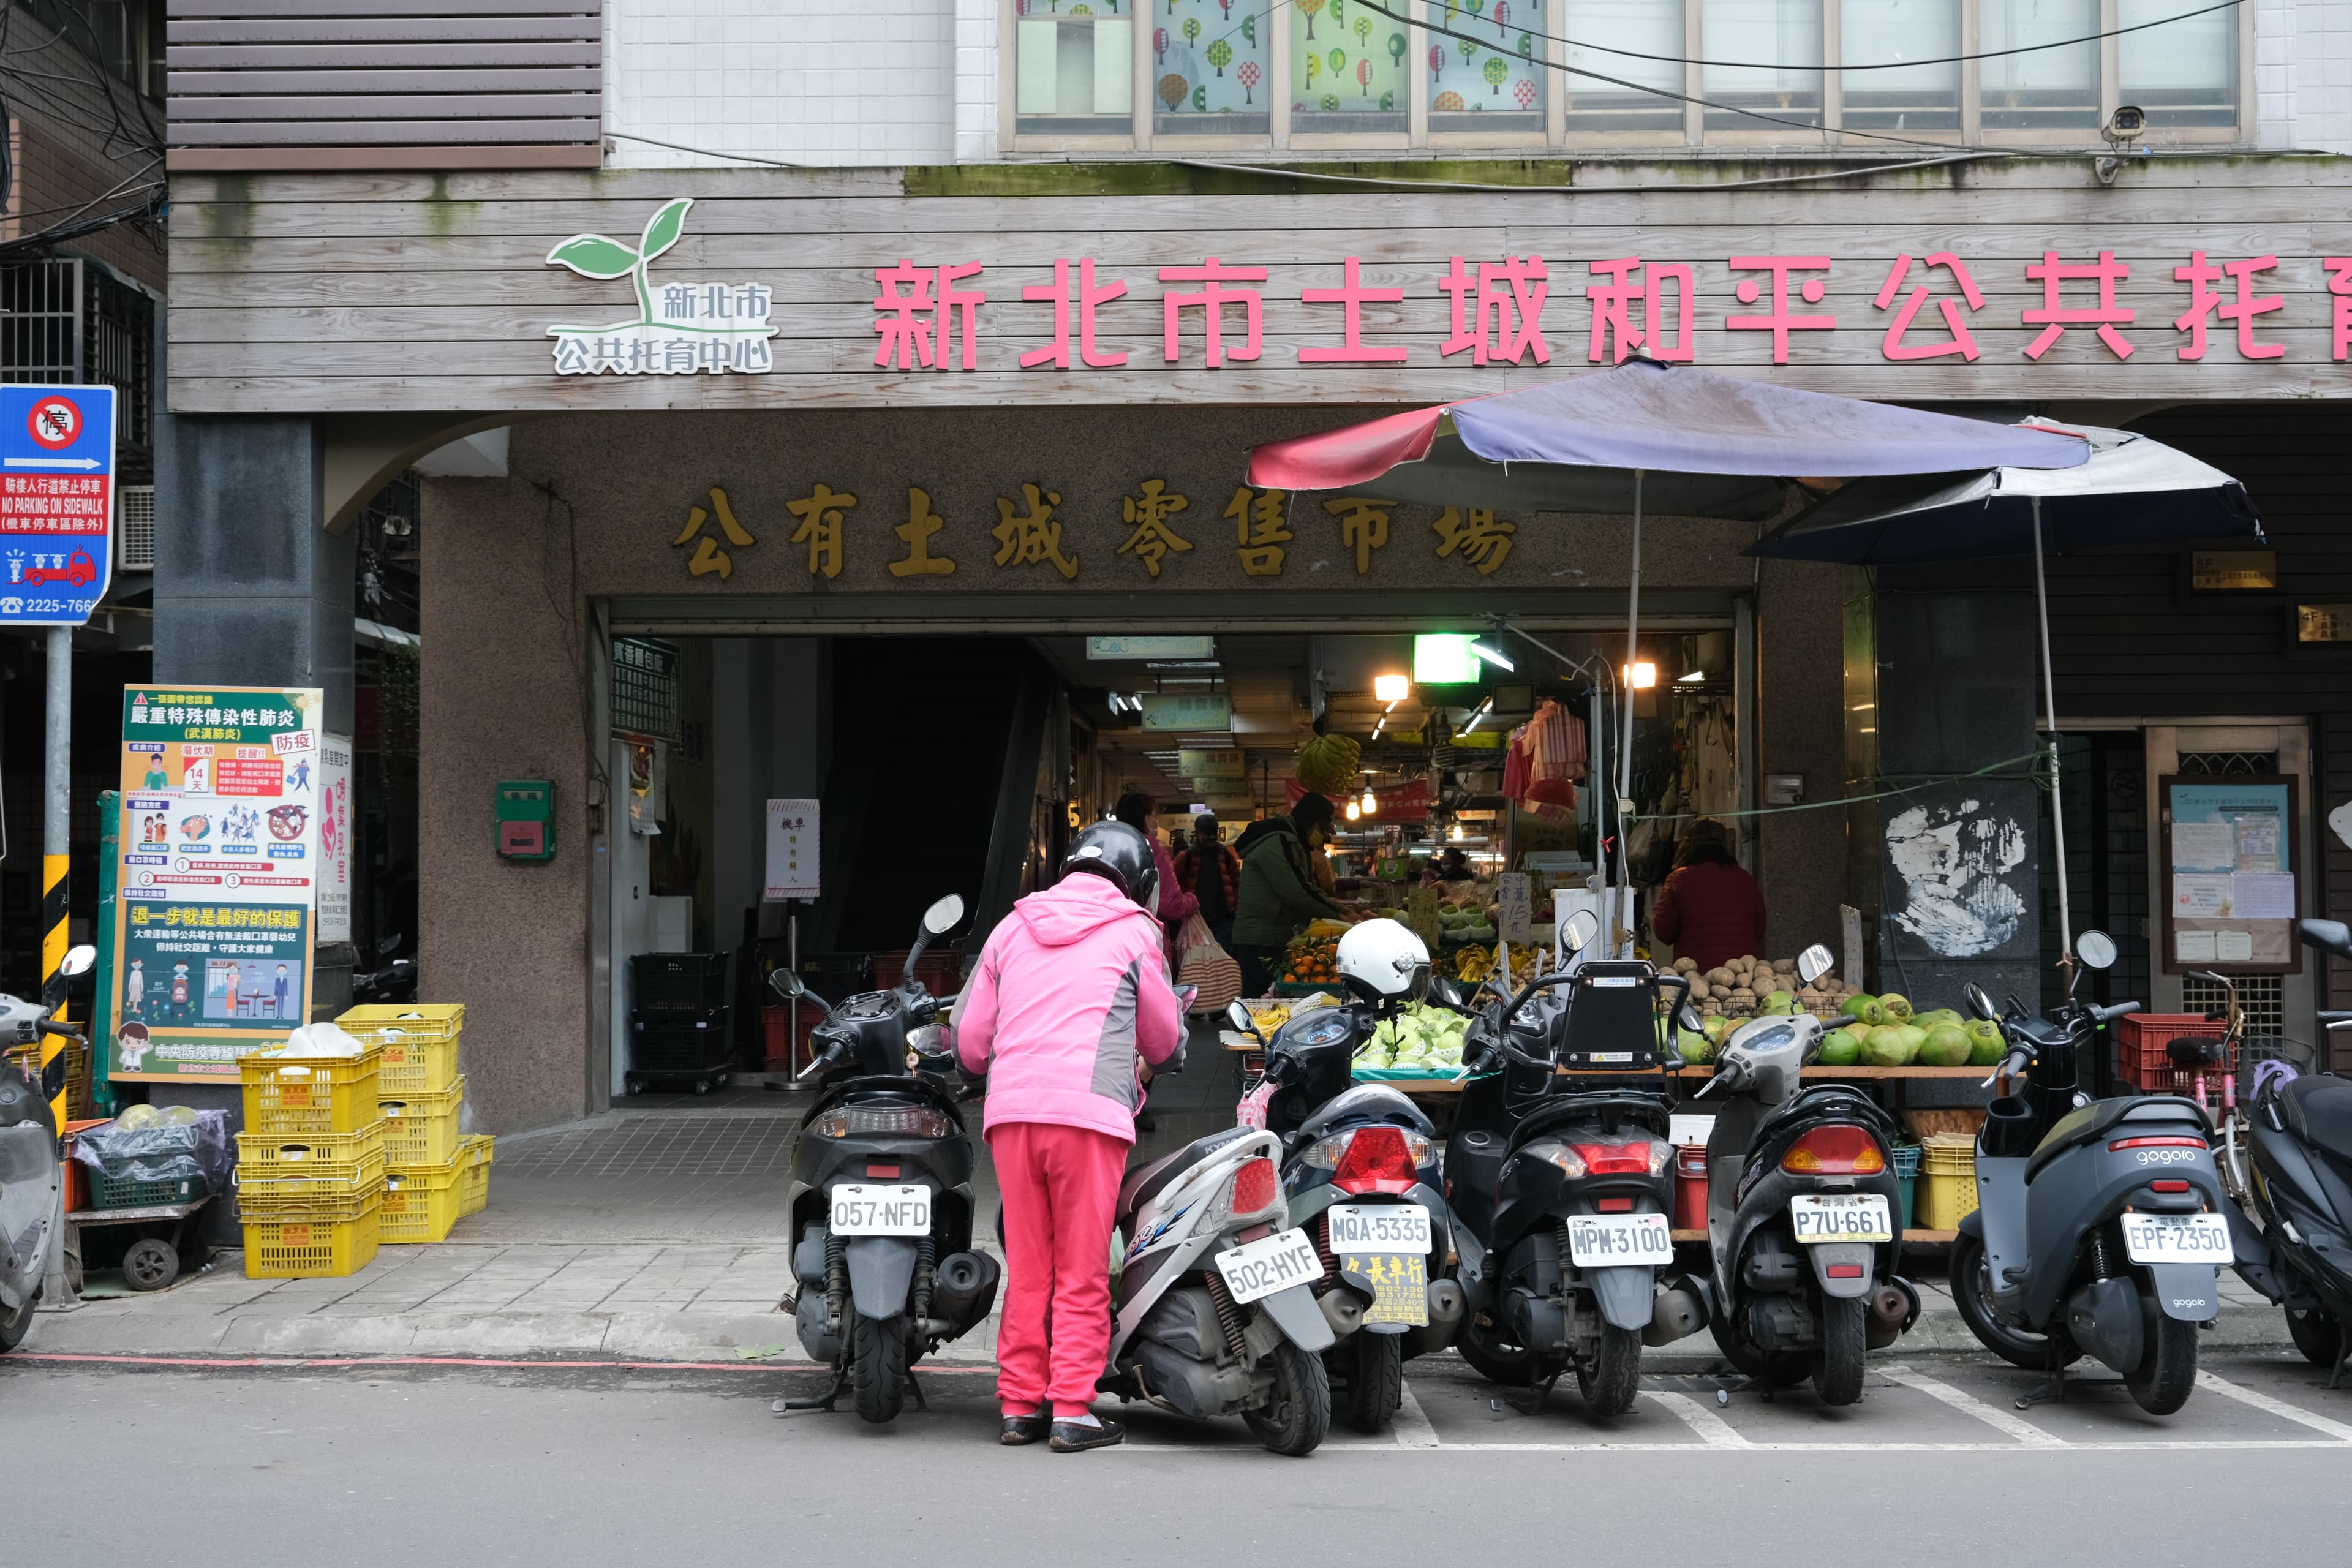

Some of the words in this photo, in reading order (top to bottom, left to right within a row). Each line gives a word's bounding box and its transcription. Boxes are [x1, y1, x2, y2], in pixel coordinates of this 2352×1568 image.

[664, 286, 768, 319] 新北市
[873, 252, 2352, 369] 新北市土城和平公共托
[557, 337, 768, 371] 公共托育中心
[5, 477, 101, 496] 騎樓人行道禁止停車
[2, 497, 14, 513] NO
[15, 497, 48, 514] PARKING
[50, 498, 61, 514] ON
[64, 499, 103, 516] SIDEWALK
[1, 517, 103, 532] (機車停車區除外)
[673, 479, 1517, 579] 公有土城零售市場
[26, 598, 94, 612] 2225-766
[130, 706, 295, 727] 嚴重特殊傳染性肺炎
[184, 728, 241, 741] (武漢肺炎)
[277, 733, 309, 751] 防疫
[183, 745, 213, 756] 潛伏期
[190, 769, 203, 778] 14
[780, 816, 805, 832] 機車
[788, 835, 798, 883] 請勿騎入
[144, 875, 149, 883] 2
[132, 907, 301, 928] 退一步就是最好的保護
[178, 1064, 241, 1073] 新北市土城區公
[1204, 1138, 1237, 1155] KYM
[2136, 1149, 2195, 1165] gogoro
[1822, 1197, 1858, 1207] 台灣省
[2158, 1216, 2190, 1226] 電動車
[2173, 1298, 2206, 1308] gogoro
